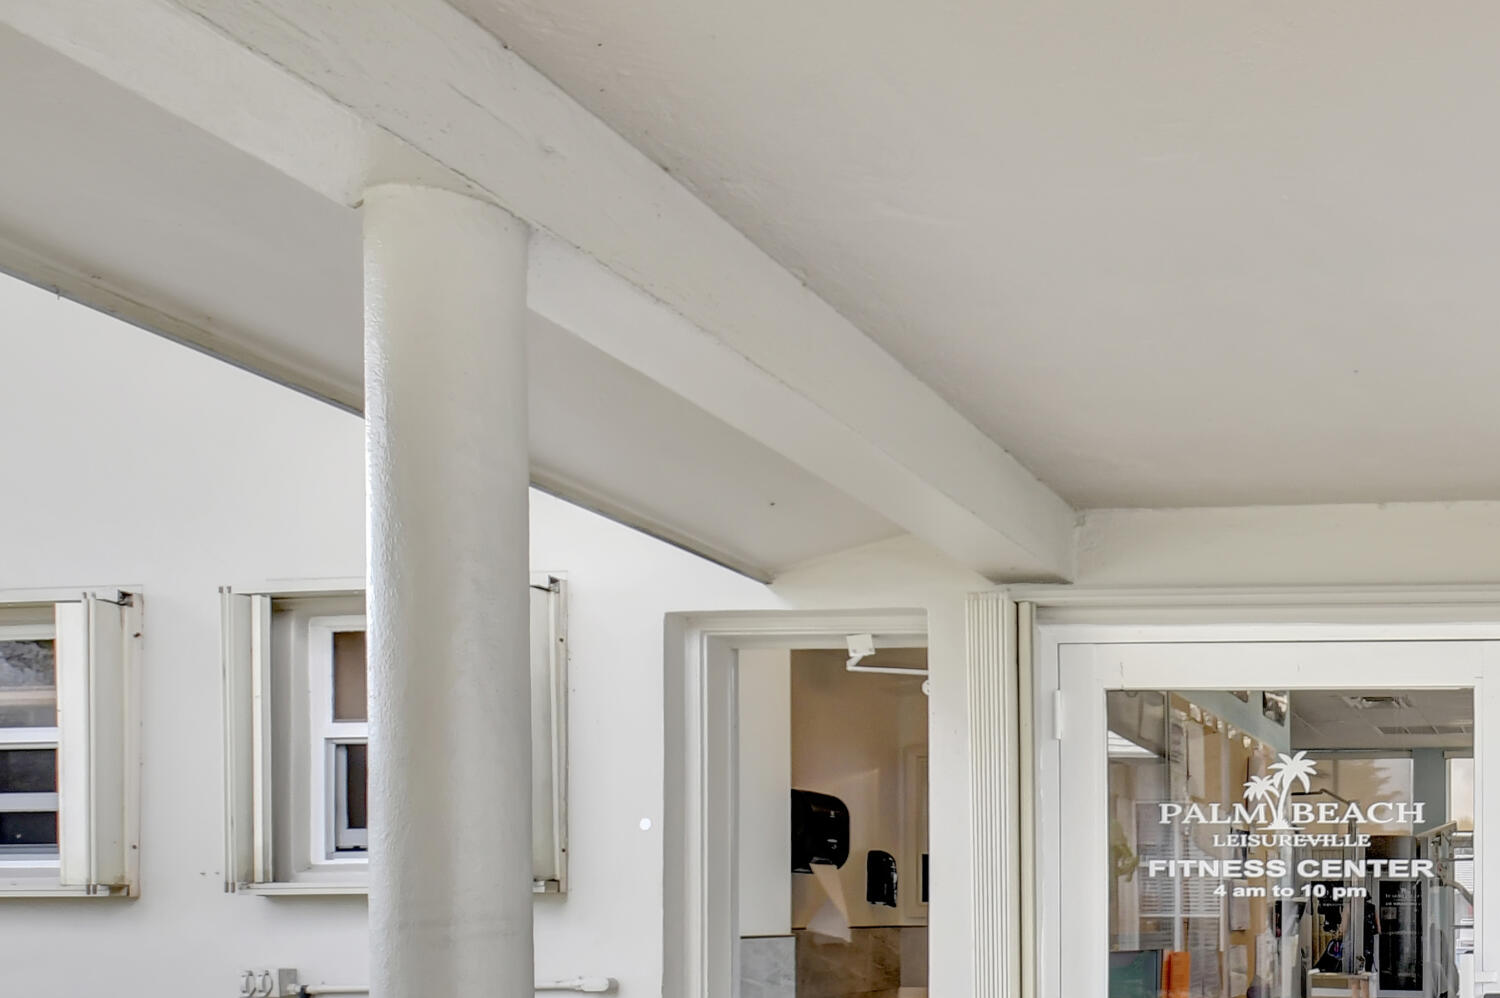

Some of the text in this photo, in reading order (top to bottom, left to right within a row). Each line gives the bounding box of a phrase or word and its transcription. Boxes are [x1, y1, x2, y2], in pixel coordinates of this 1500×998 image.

[1158, 802, 1426, 825] PALM BEACH
[1213, 834, 1372, 848] LEISUREVILLE
[1149, 859, 1434, 878] FITNESS CENTER
[1213, 884, 1367, 901] 4 am to 10 pm
